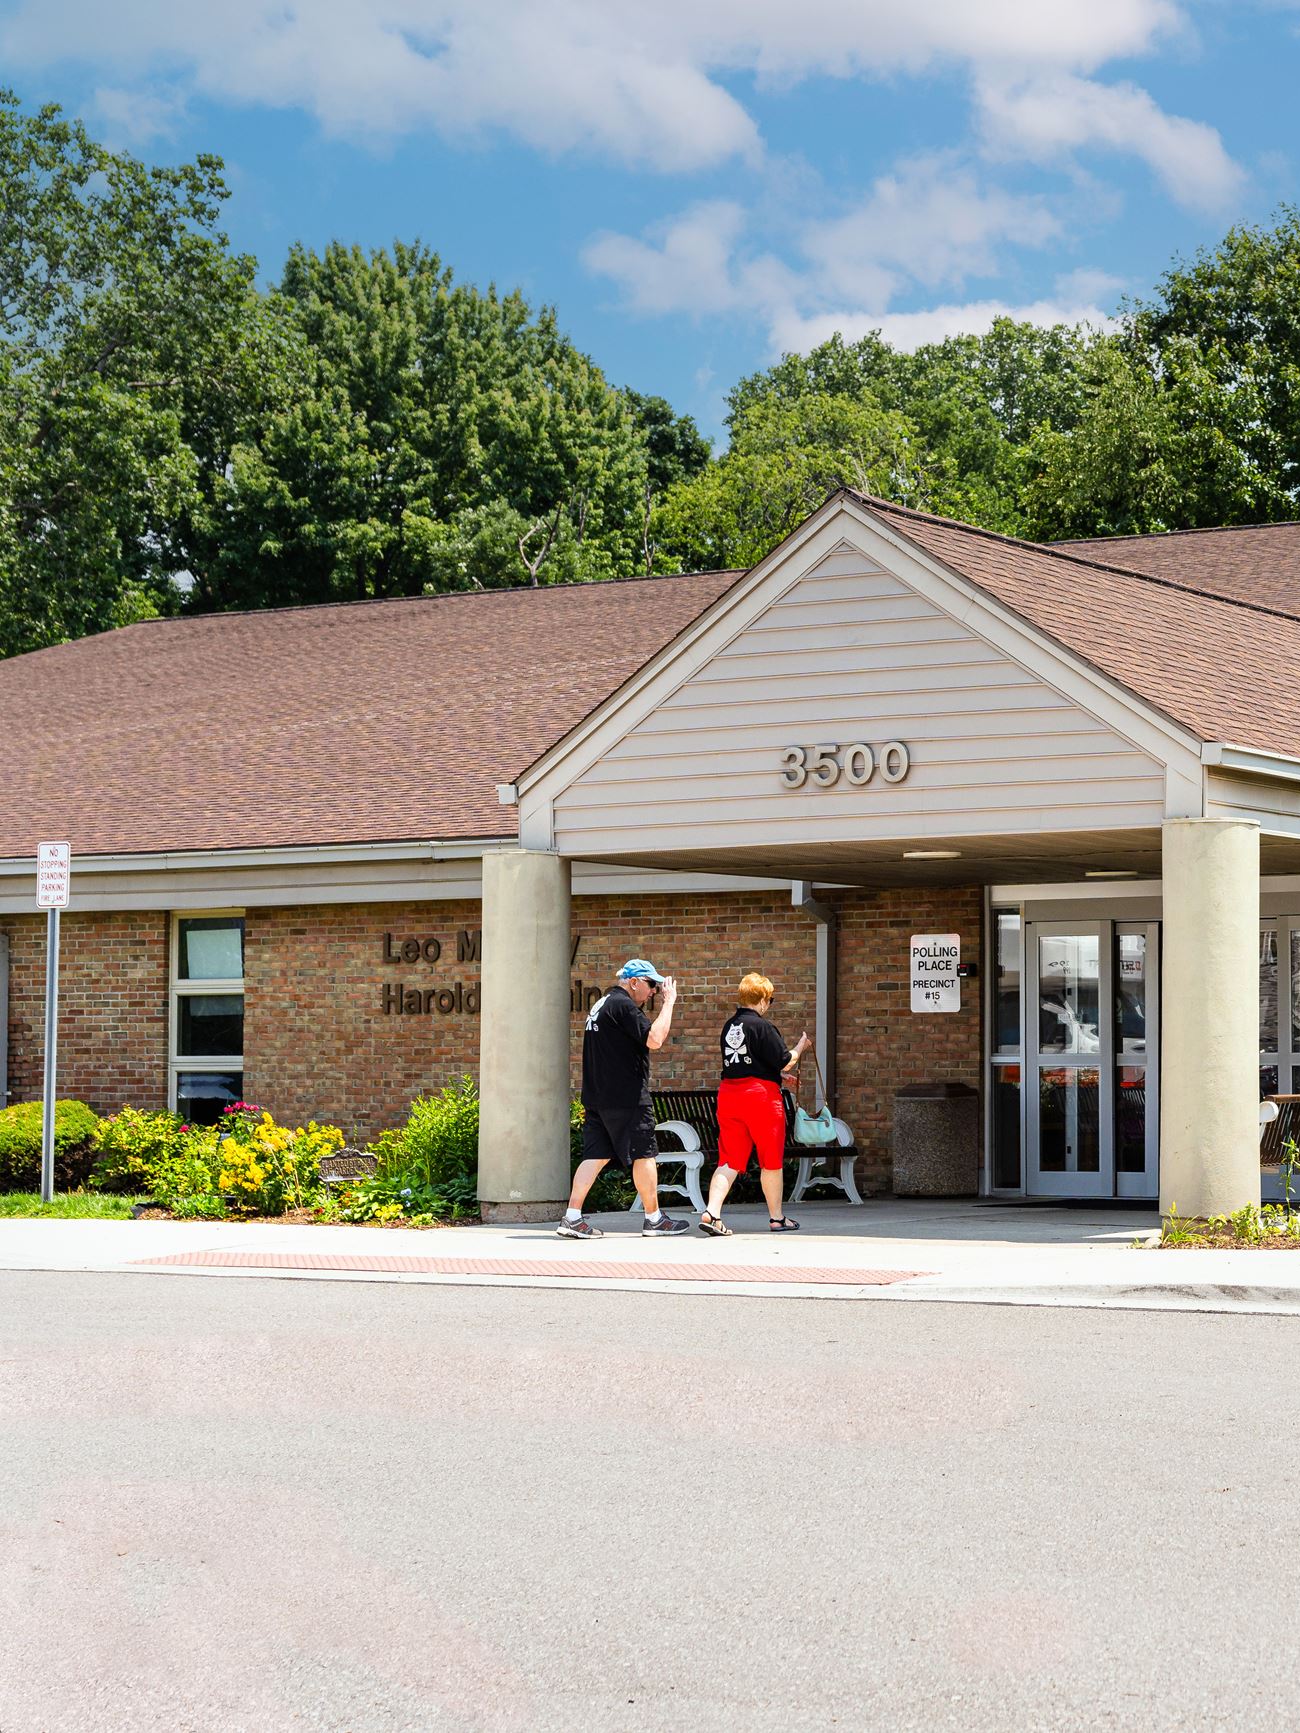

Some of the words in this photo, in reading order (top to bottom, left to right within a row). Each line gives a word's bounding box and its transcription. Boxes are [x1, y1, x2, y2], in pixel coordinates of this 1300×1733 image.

[780, 741, 909, 789] 3500
[49, 849, 59, 857] NO
[41, 860, 67, 868] STOPPING
[41, 872, 66, 880] STANDING
[41, 883, 64, 891] PARKING
[383, 932, 441, 963] Leo
[912, 946, 958, 957] POLLING
[918, 960, 952, 971] PLACE
[912, 980, 955, 988] PRECINCT
[382, 982, 482, 1015] Harold
[925, 991, 940, 1000] #15
